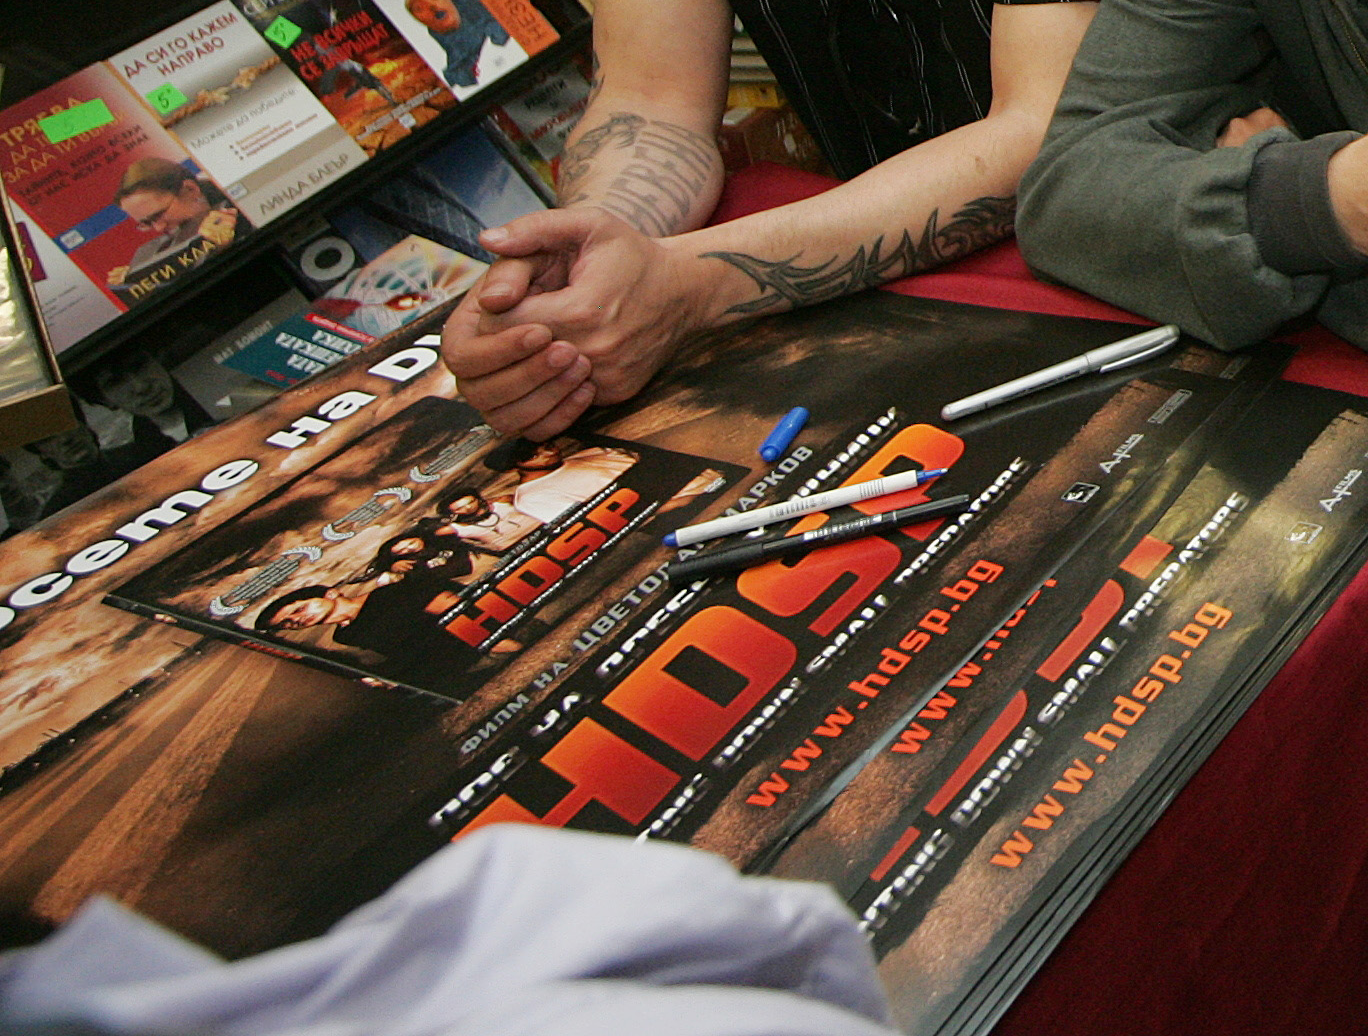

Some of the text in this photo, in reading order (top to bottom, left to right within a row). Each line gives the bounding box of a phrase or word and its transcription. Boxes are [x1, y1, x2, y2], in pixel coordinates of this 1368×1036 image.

[123, 12, 239, 80] ДА СИ ГО КАЖЕМ
[157, 36, 225, 77] НАПРАВО
[258, 152, 350, 217] ЛИНДА БЛЕЪР
[128, 264, 176, 299] ПЕГИ
[445, 486, 641, 648] HDSP
[451, 421, 965, 844] HDSP
[713, 677, 803, 766] DOWN
[806, 594, 892, 677] SMALL
[894, 455, 1031, 588] PREDATORS
[459, 695, 532, 756] ФИЛМ
[533, 659, 571, 693] НА
[746, 556, 1004, 811] www.hdsp.bg
[949, 725, 1041, 824] DOWN
[1037, 636, 1120, 726] SMALL
[1120, 491, 1251, 632] PREDATORS
[990, 598, 1233, 871] www.hdsp.bg
